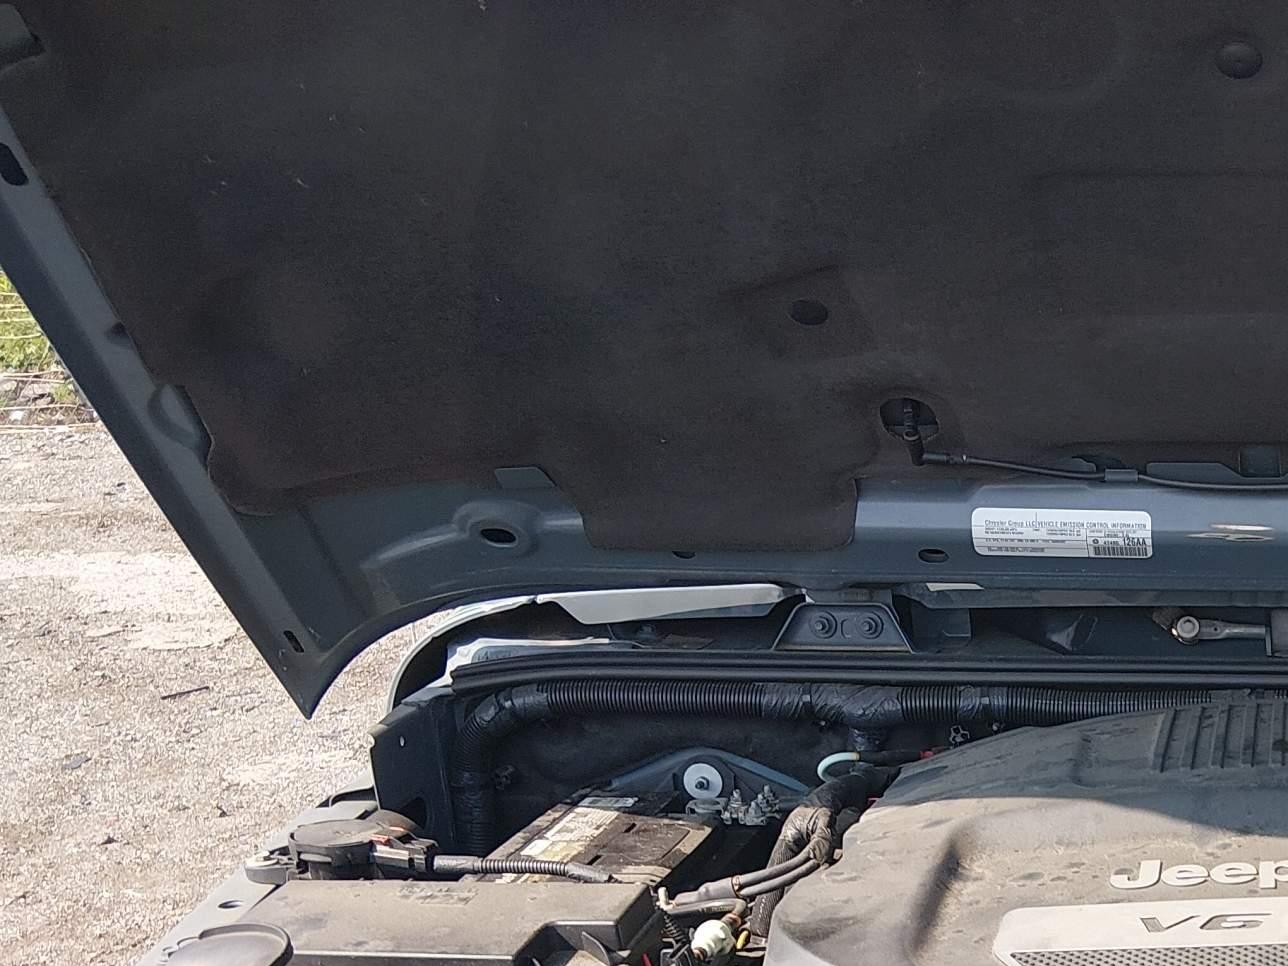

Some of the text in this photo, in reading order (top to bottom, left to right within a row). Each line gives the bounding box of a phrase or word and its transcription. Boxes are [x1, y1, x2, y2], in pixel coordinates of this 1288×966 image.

[1037, 520, 1059, 529] VEHICLE
[1060, 521, 1084, 529] EMISSION
[1086, 521, 1109, 529] CONTROL
[1139, 913, 1272, 933] V6
